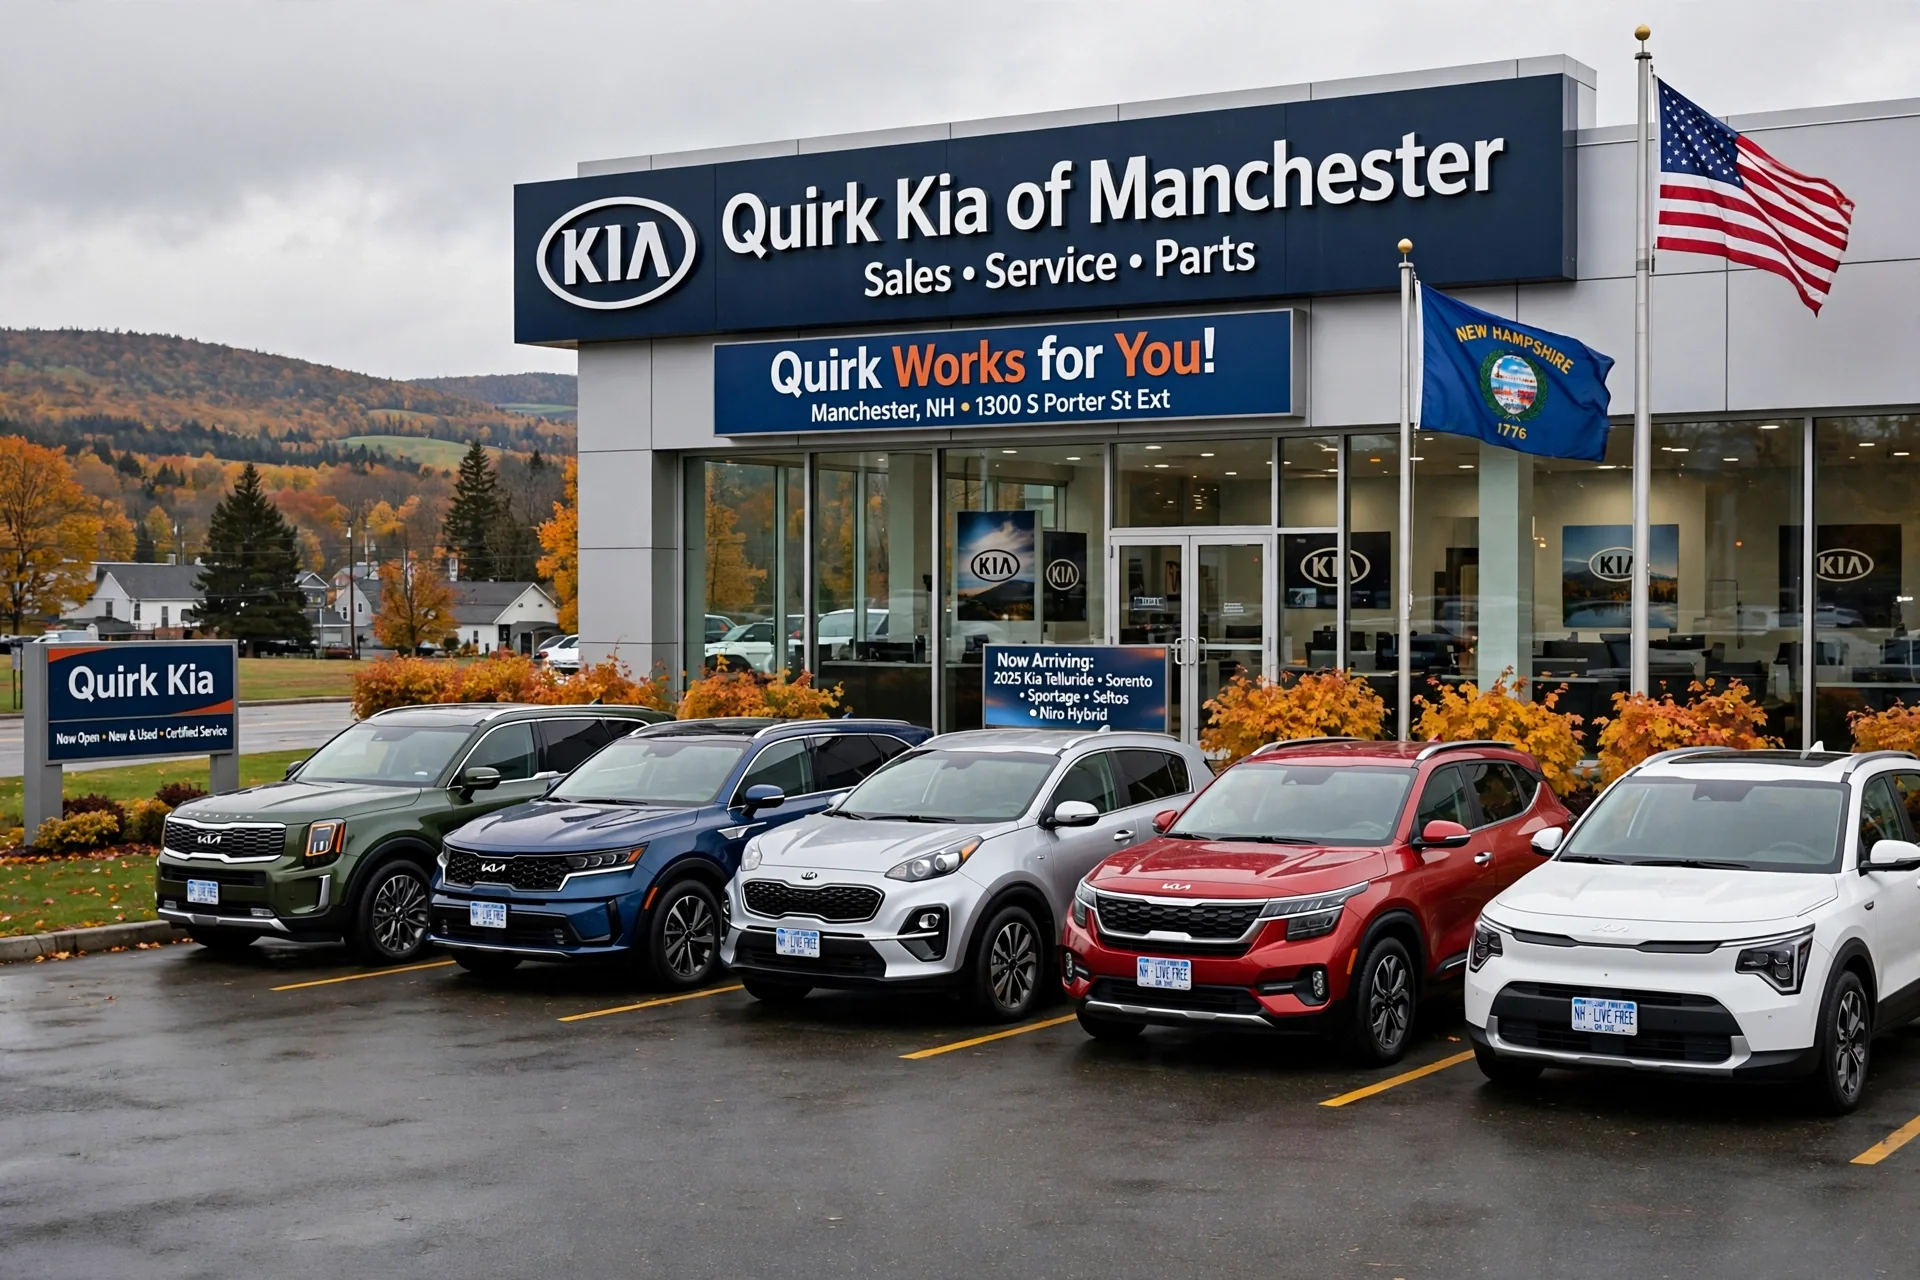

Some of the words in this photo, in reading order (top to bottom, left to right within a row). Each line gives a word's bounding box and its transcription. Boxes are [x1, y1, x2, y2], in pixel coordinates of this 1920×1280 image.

[722, 181, 880, 259] Quirk
[897, 172, 989, 241] Kia
[1006, 160, 1073, 231] of
[1089, 132, 1504, 226] Manchester
[561, 221, 672, 287] KIA
[864, 262, 952, 298] Sales
[985, 245, 1117, 290] Service
[1155, 236, 1256, 278] Parts
[1455, 324, 1488, 343] NEW
[1493, 326, 1574, 375] HAMPSHIRE
[770, 346, 883, 398] Quirk
[892, 340, 1025, 388] Works
[1038, 335, 1104, 381] for
[1115, 327, 1215, 377] You!
[811, 399, 920, 424] Manchester,
[926, 398, 955, 419] NH
[976, 394, 1021, 416] 1300
[1026, 394, 1038, 415] S
[1044, 391, 1105, 414] Porter
[1111, 390, 1132, 411] St
[1137, 388, 1170, 410] Ext
[1497, 423, 1527, 440] 1776
[979, 557, 1012, 574] KIA
[1052, 566, 1074, 583] KIA
[1820, 556, 1863, 574] KIA
[997, 652, 1029, 668] Now
[1032, 653, 1095, 671] Arriving:
[68, 663, 159, 702] Quirk
[167, 663, 214, 695] Kia
[993, 671, 1022, 685] 2025
[1024, 672, 1042, 685] Kia
[1045, 672, 1094, 686] Telluride
[1105, 673, 1153, 688] Sorento
[1028, 688, 1080, 706] Sportage
[1039, 707, 1065, 720] Niro
[1067, 708, 1108, 724] Hybrid
[56, 733, 76, 745] Now
[78, 732, 100, 746] Open
[108, 731, 127, 742] New
[129, 730, 136, 741] &
[137, 728, 157, 741] Used
[166, 725, 198, 739] Certified
[199, 724, 227, 737] Service
[1155, 965, 1170, 980] LIVE
[1171, 967, 1189, 982] FREE
[1574, 1005, 1586, 1021] NH
[1593, 1007, 1612, 1024] LIVE
[1614, 1010, 1635, 1026] FREE
